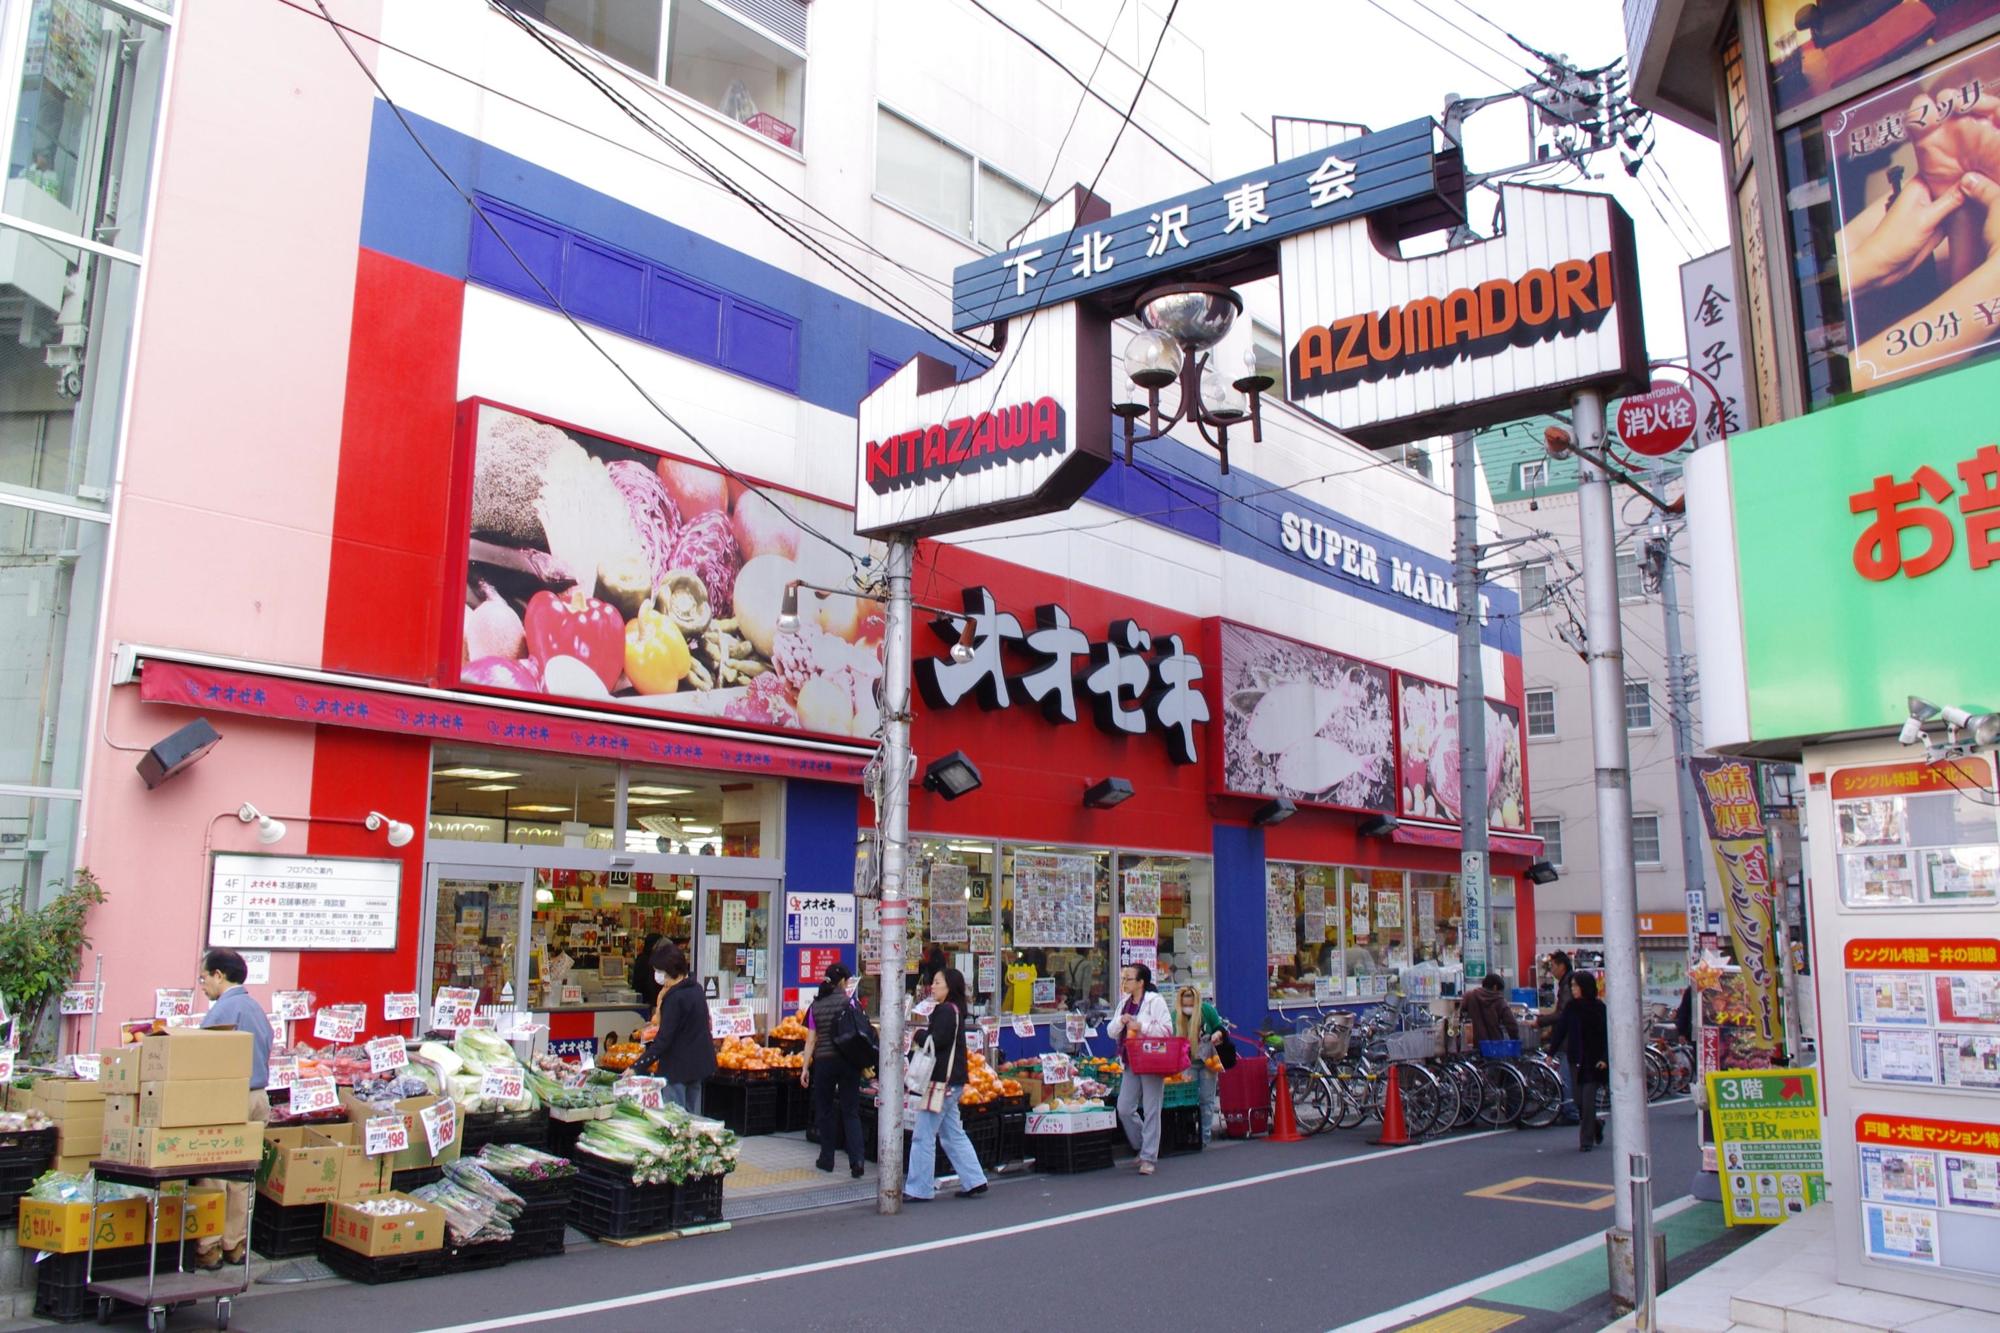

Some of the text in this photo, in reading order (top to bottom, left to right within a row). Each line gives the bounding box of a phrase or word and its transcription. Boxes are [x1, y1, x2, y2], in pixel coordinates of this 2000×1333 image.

[1004, 155, 1358, 296] 下北沢東会
[1300, 250, 1614, 380] AZUMADORI
[1885, 312, 1962, 357] 30分
[1646, 385, 1681, 401] HYDRANT
[1623, 398, 1692, 438] 消火栓
[864, 395, 1060, 486] KITAZAWA
[1281, 512, 1490, 627] SUPER MARKT
[914, 586, 1210, 764] オオゼキ
[286, 866, 333, 875] フロアのご案内
[225, 878, 239, 888] 4F
[279, 882, 317, 890] 本部事務所
[973, 881, 982, 897] 6
[224, 896, 238, 905] 3F
[803, 898, 836, 912] オオゼキ
[1466, 875, 1479, 940] こいぬま歯科
[222, 913, 236, 922] 2F
[222, 930, 236, 939] 1F
[84, 997, 97, 1010] 19
[1721, 1078, 1764, 1100] 3階
[315, 1091, 334, 1107] 88
[1722, 1110, 1816, 1121] お売りください
[1723, 1121, 1818, 1141] 買取 専門店
[1864, 1120, 2000, 1149] 戸建・大型マンション特
[188, 1138, 230, 1150] ピーマン
[33, 1218, 62, 1236] セルリー
